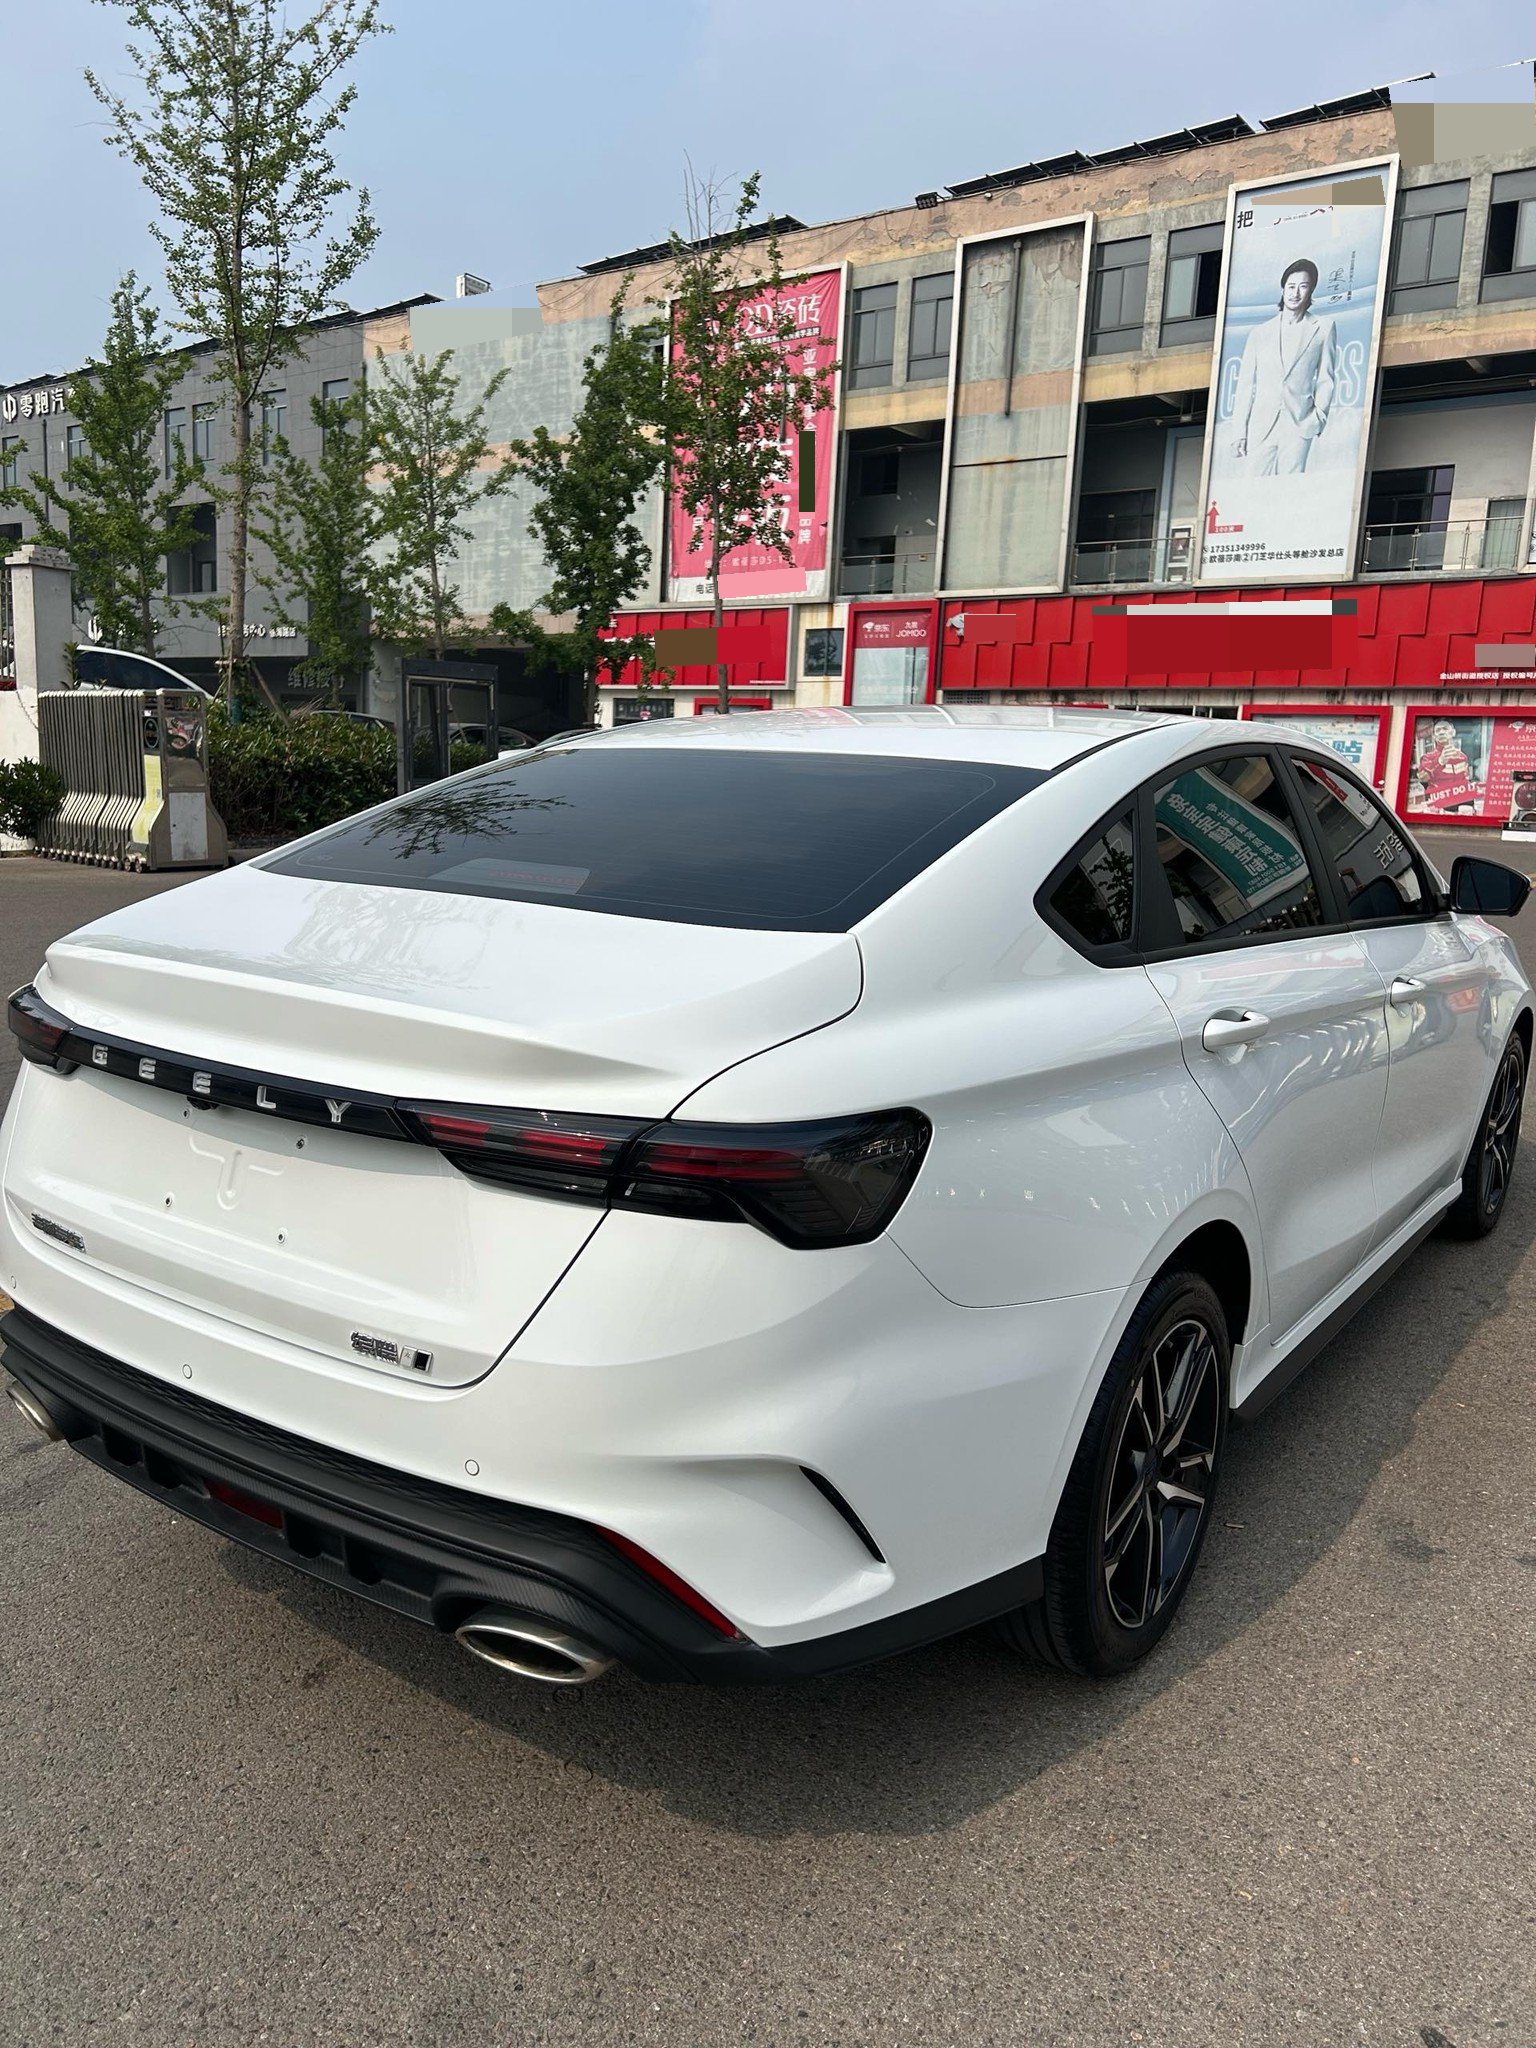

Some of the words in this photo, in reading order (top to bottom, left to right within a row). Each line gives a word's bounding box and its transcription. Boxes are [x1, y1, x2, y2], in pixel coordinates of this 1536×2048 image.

[1237, 210, 1254, 229] 把
[20, 387, 76, 418] 零跑汽
[895, 629, 927, 638] JOMOO
[1428, 789, 1451, 803] JUST
[1452, 785, 1466, 796] DO
[1467, 781, 1477, 792] IT
[92, 1044, 350, 1124] GEELY
